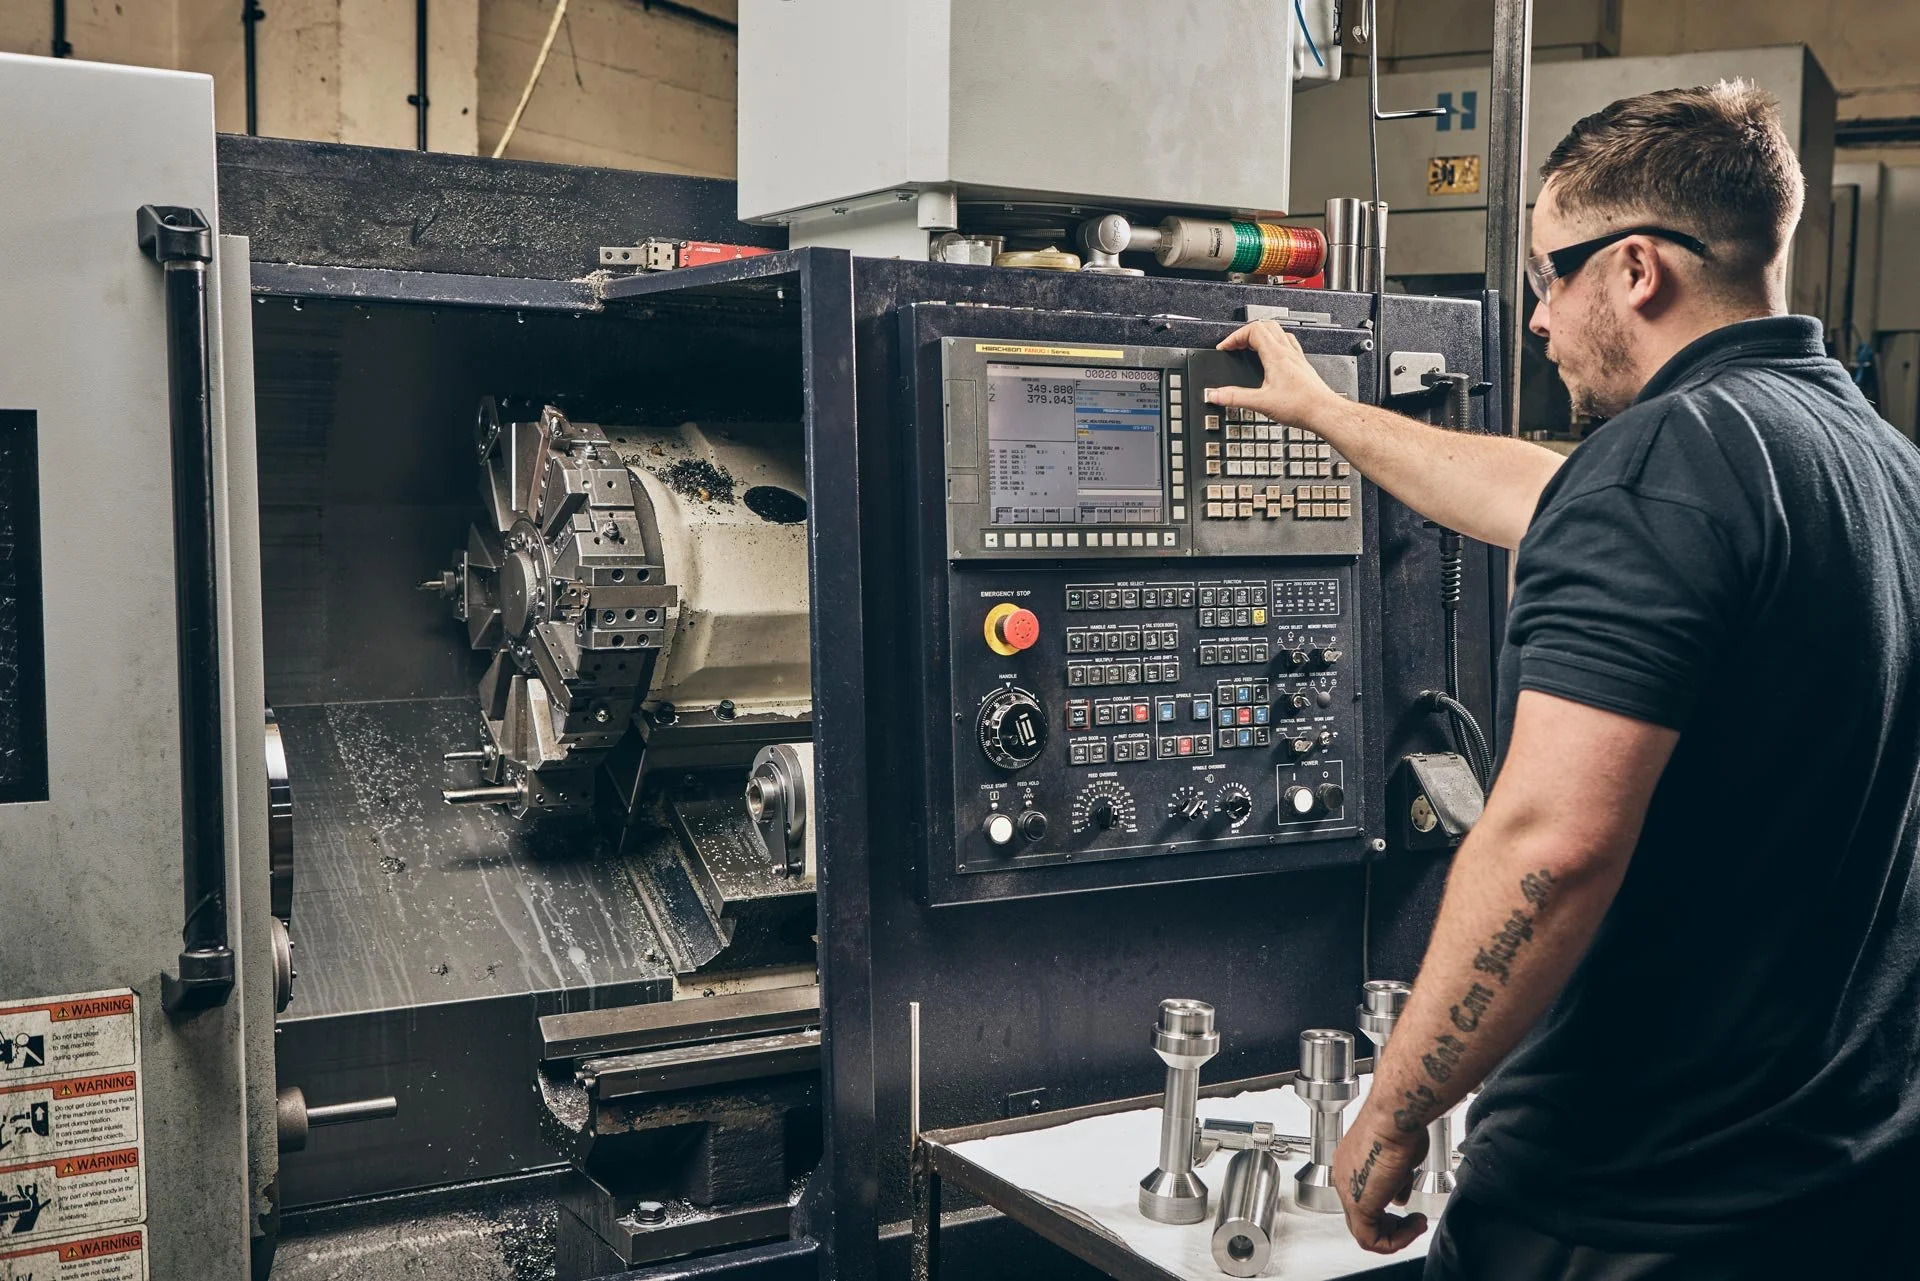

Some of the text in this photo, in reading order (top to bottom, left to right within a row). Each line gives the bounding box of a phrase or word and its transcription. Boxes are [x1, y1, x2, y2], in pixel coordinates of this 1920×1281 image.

[1027, 384, 1073, 393] 349.880
[1028, 395, 1073, 404] 379.043
[72, 999, 131, 1016] WARNING
[1450, 983, 1495, 1033] Can
[53, 1033, 61, 1041] Do
[75, 1076, 134, 1093] WARNING
[73, 1110, 96, 1118] machine
[71, 1120, 88, 1128] during
[74, 1136, 102, 1144] protruding
[77, 1153, 137, 1170] WARNING
[80, 1236, 140, 1255] WARNING
[61, 1272, 79, 1280] hands
[102, 1266, 121, 1275] caught
